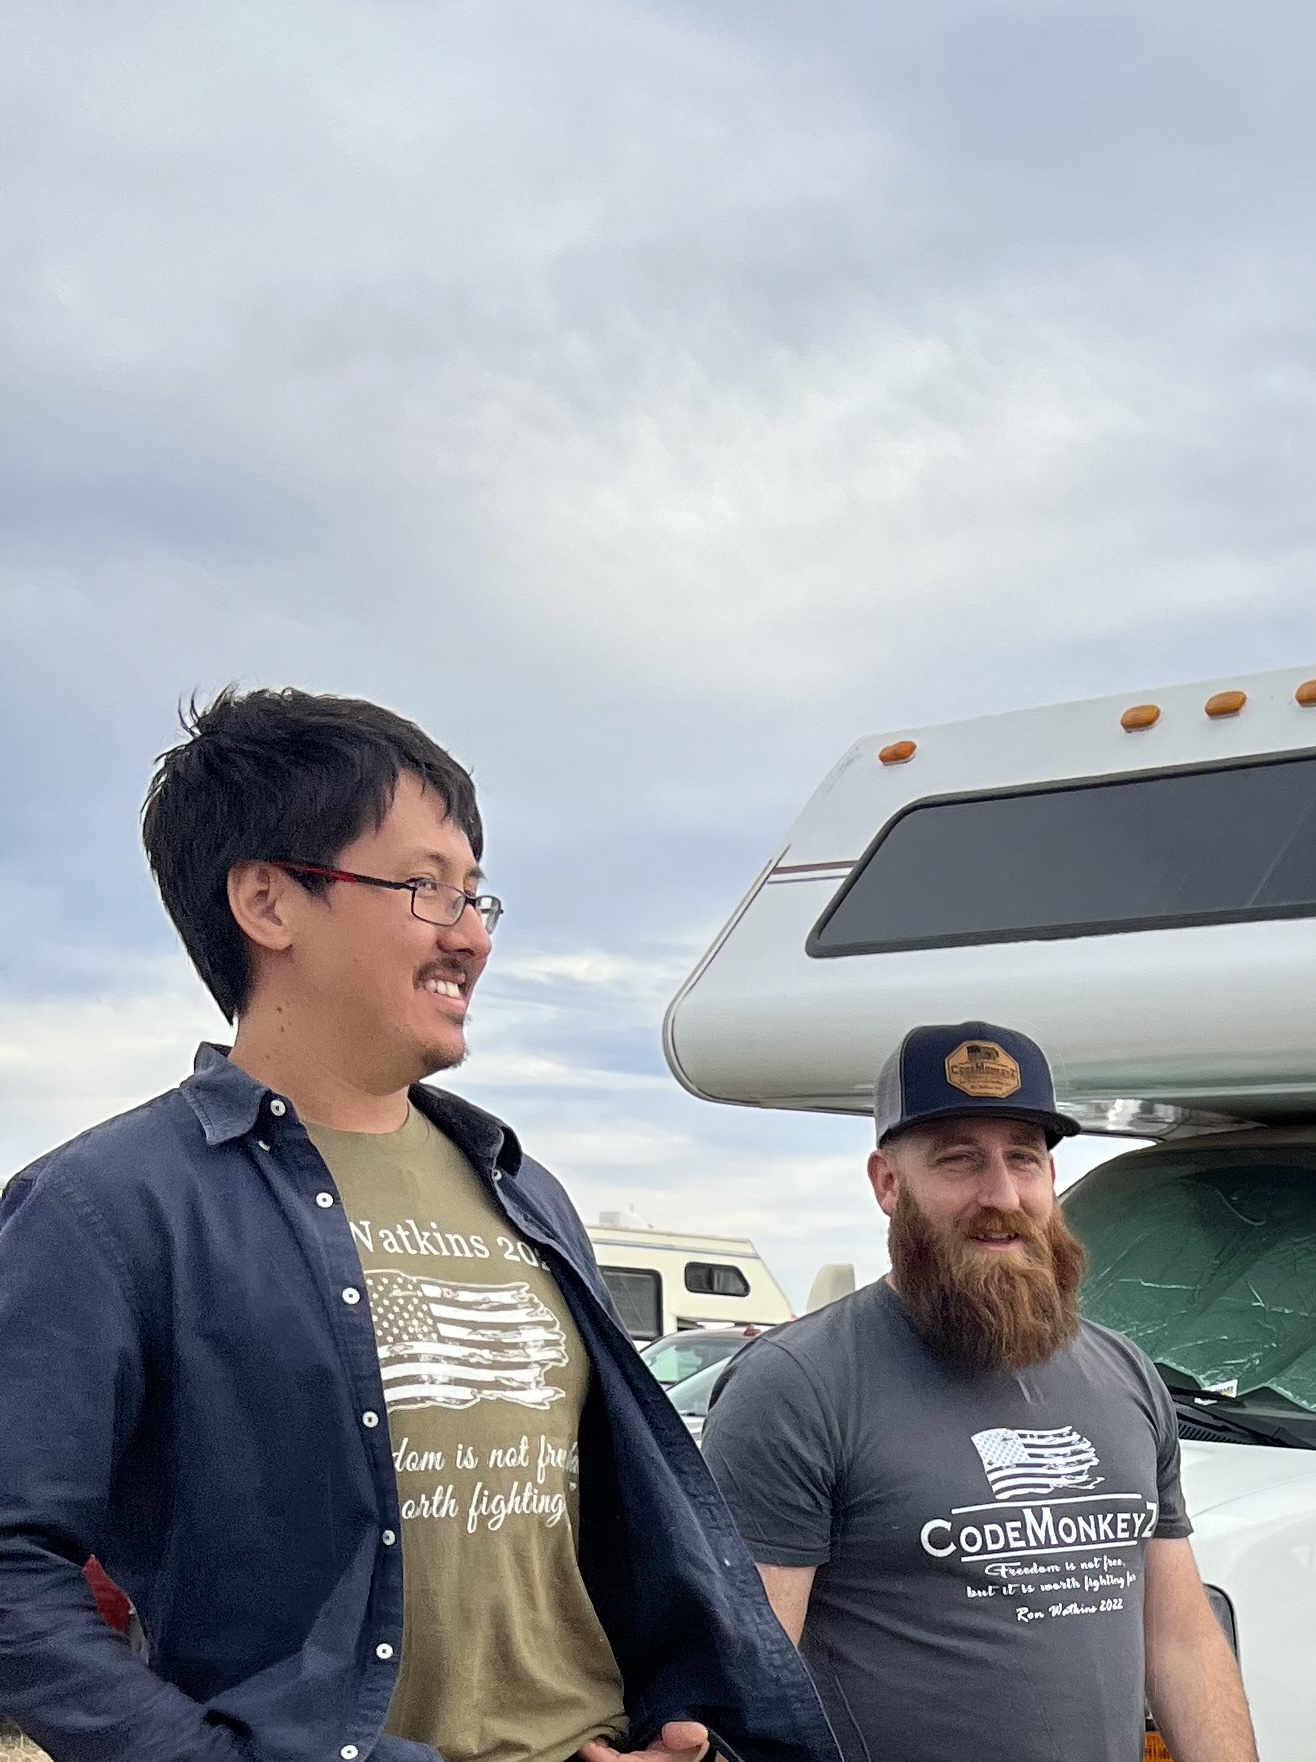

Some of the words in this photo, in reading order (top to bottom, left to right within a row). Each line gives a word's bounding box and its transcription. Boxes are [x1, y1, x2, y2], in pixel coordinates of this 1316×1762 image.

[456, 1443, 479, 1470] is
[488, 1435, 530, 1469] not
[401, 1484, 460, 1520] orth
[466, 1480, 567, 1534] fighting
[984, 1561, 1061, 1579] Freedom
[1065, 1561, 1077, 1571] is
[1080, 1556, 1102, 1570] not
[966, 1585, 999, 1599] but
[1002, 1583, 1020, 1596] it
[1021, 1583, 1035, 1594] is
[1040, 1577, 1081, 1592] worth
[1084, 1573, 1125, 1593] fighting
[1016, 1606, 1045, 1623] Ron
[1099, 1597, 1124, 1612] 2022
